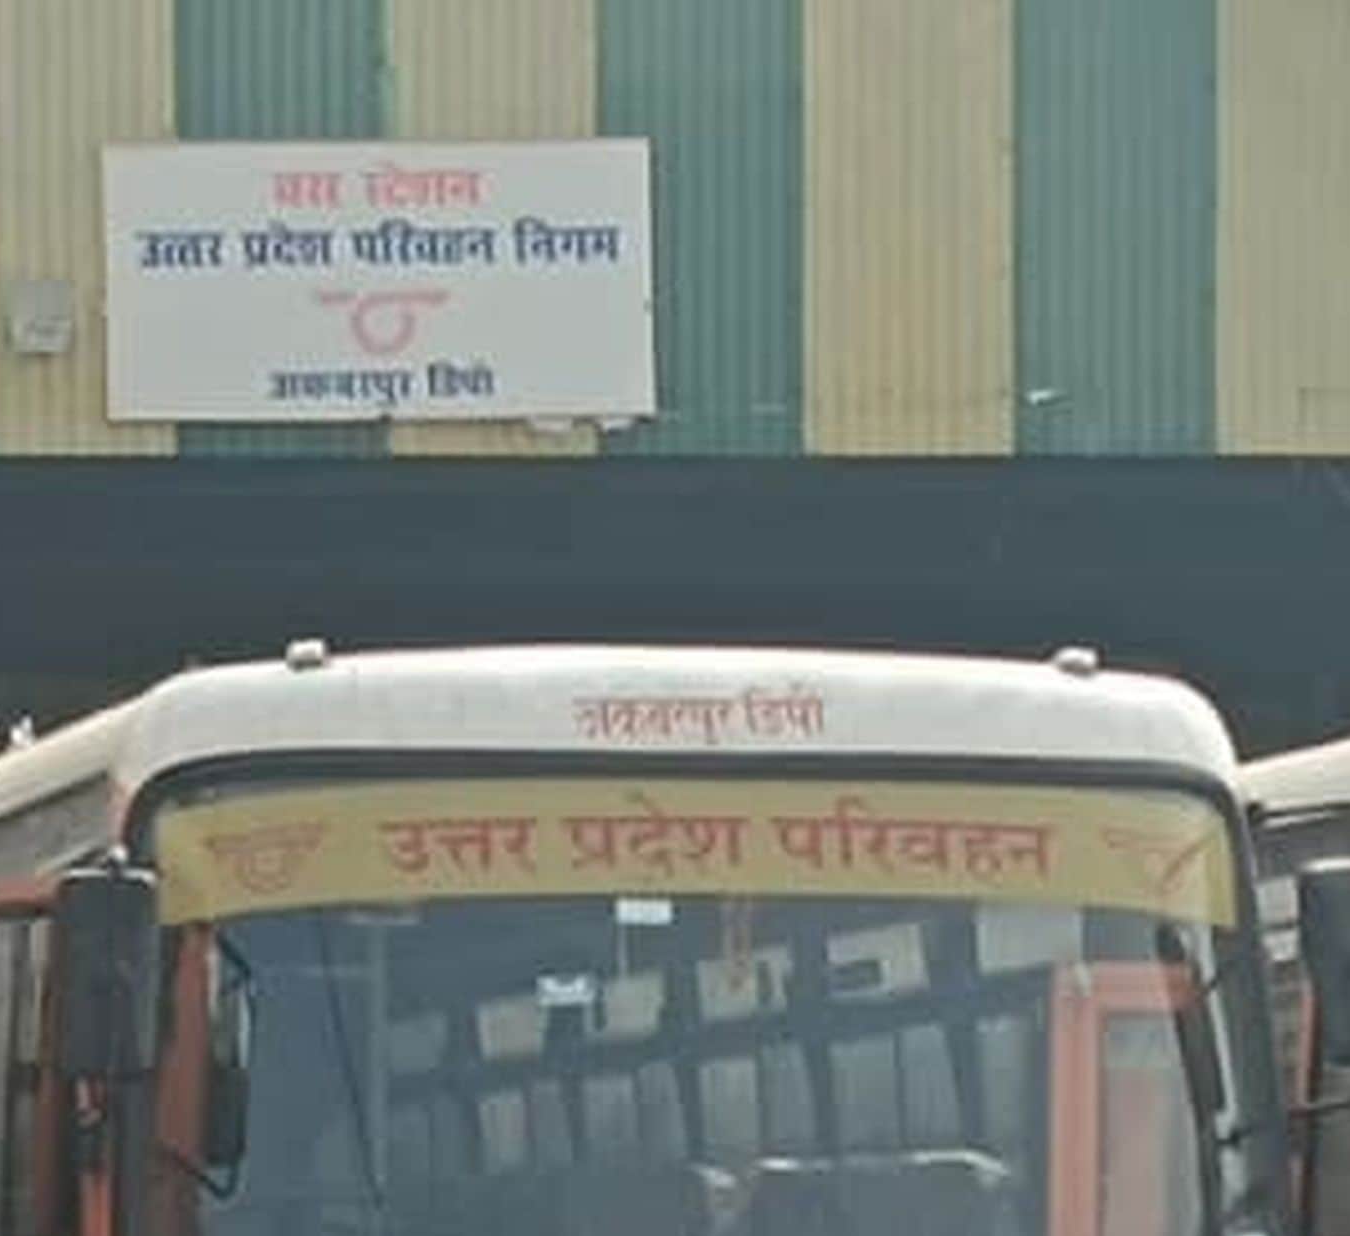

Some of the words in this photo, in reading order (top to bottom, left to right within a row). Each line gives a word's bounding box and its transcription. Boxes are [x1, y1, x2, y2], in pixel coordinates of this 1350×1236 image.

[135, 230, 222, 269] उत्तर
[241, 222, 333, 268] प्रदेश
[351, 218, 496, 266] परिवहन
[514, 217, 620, 265] निगम
[378, 817, 537, 875] उत्तर
[562, 792, 749, 876] प्रदेश
[769, 796, 1059, 879] परिवहन
